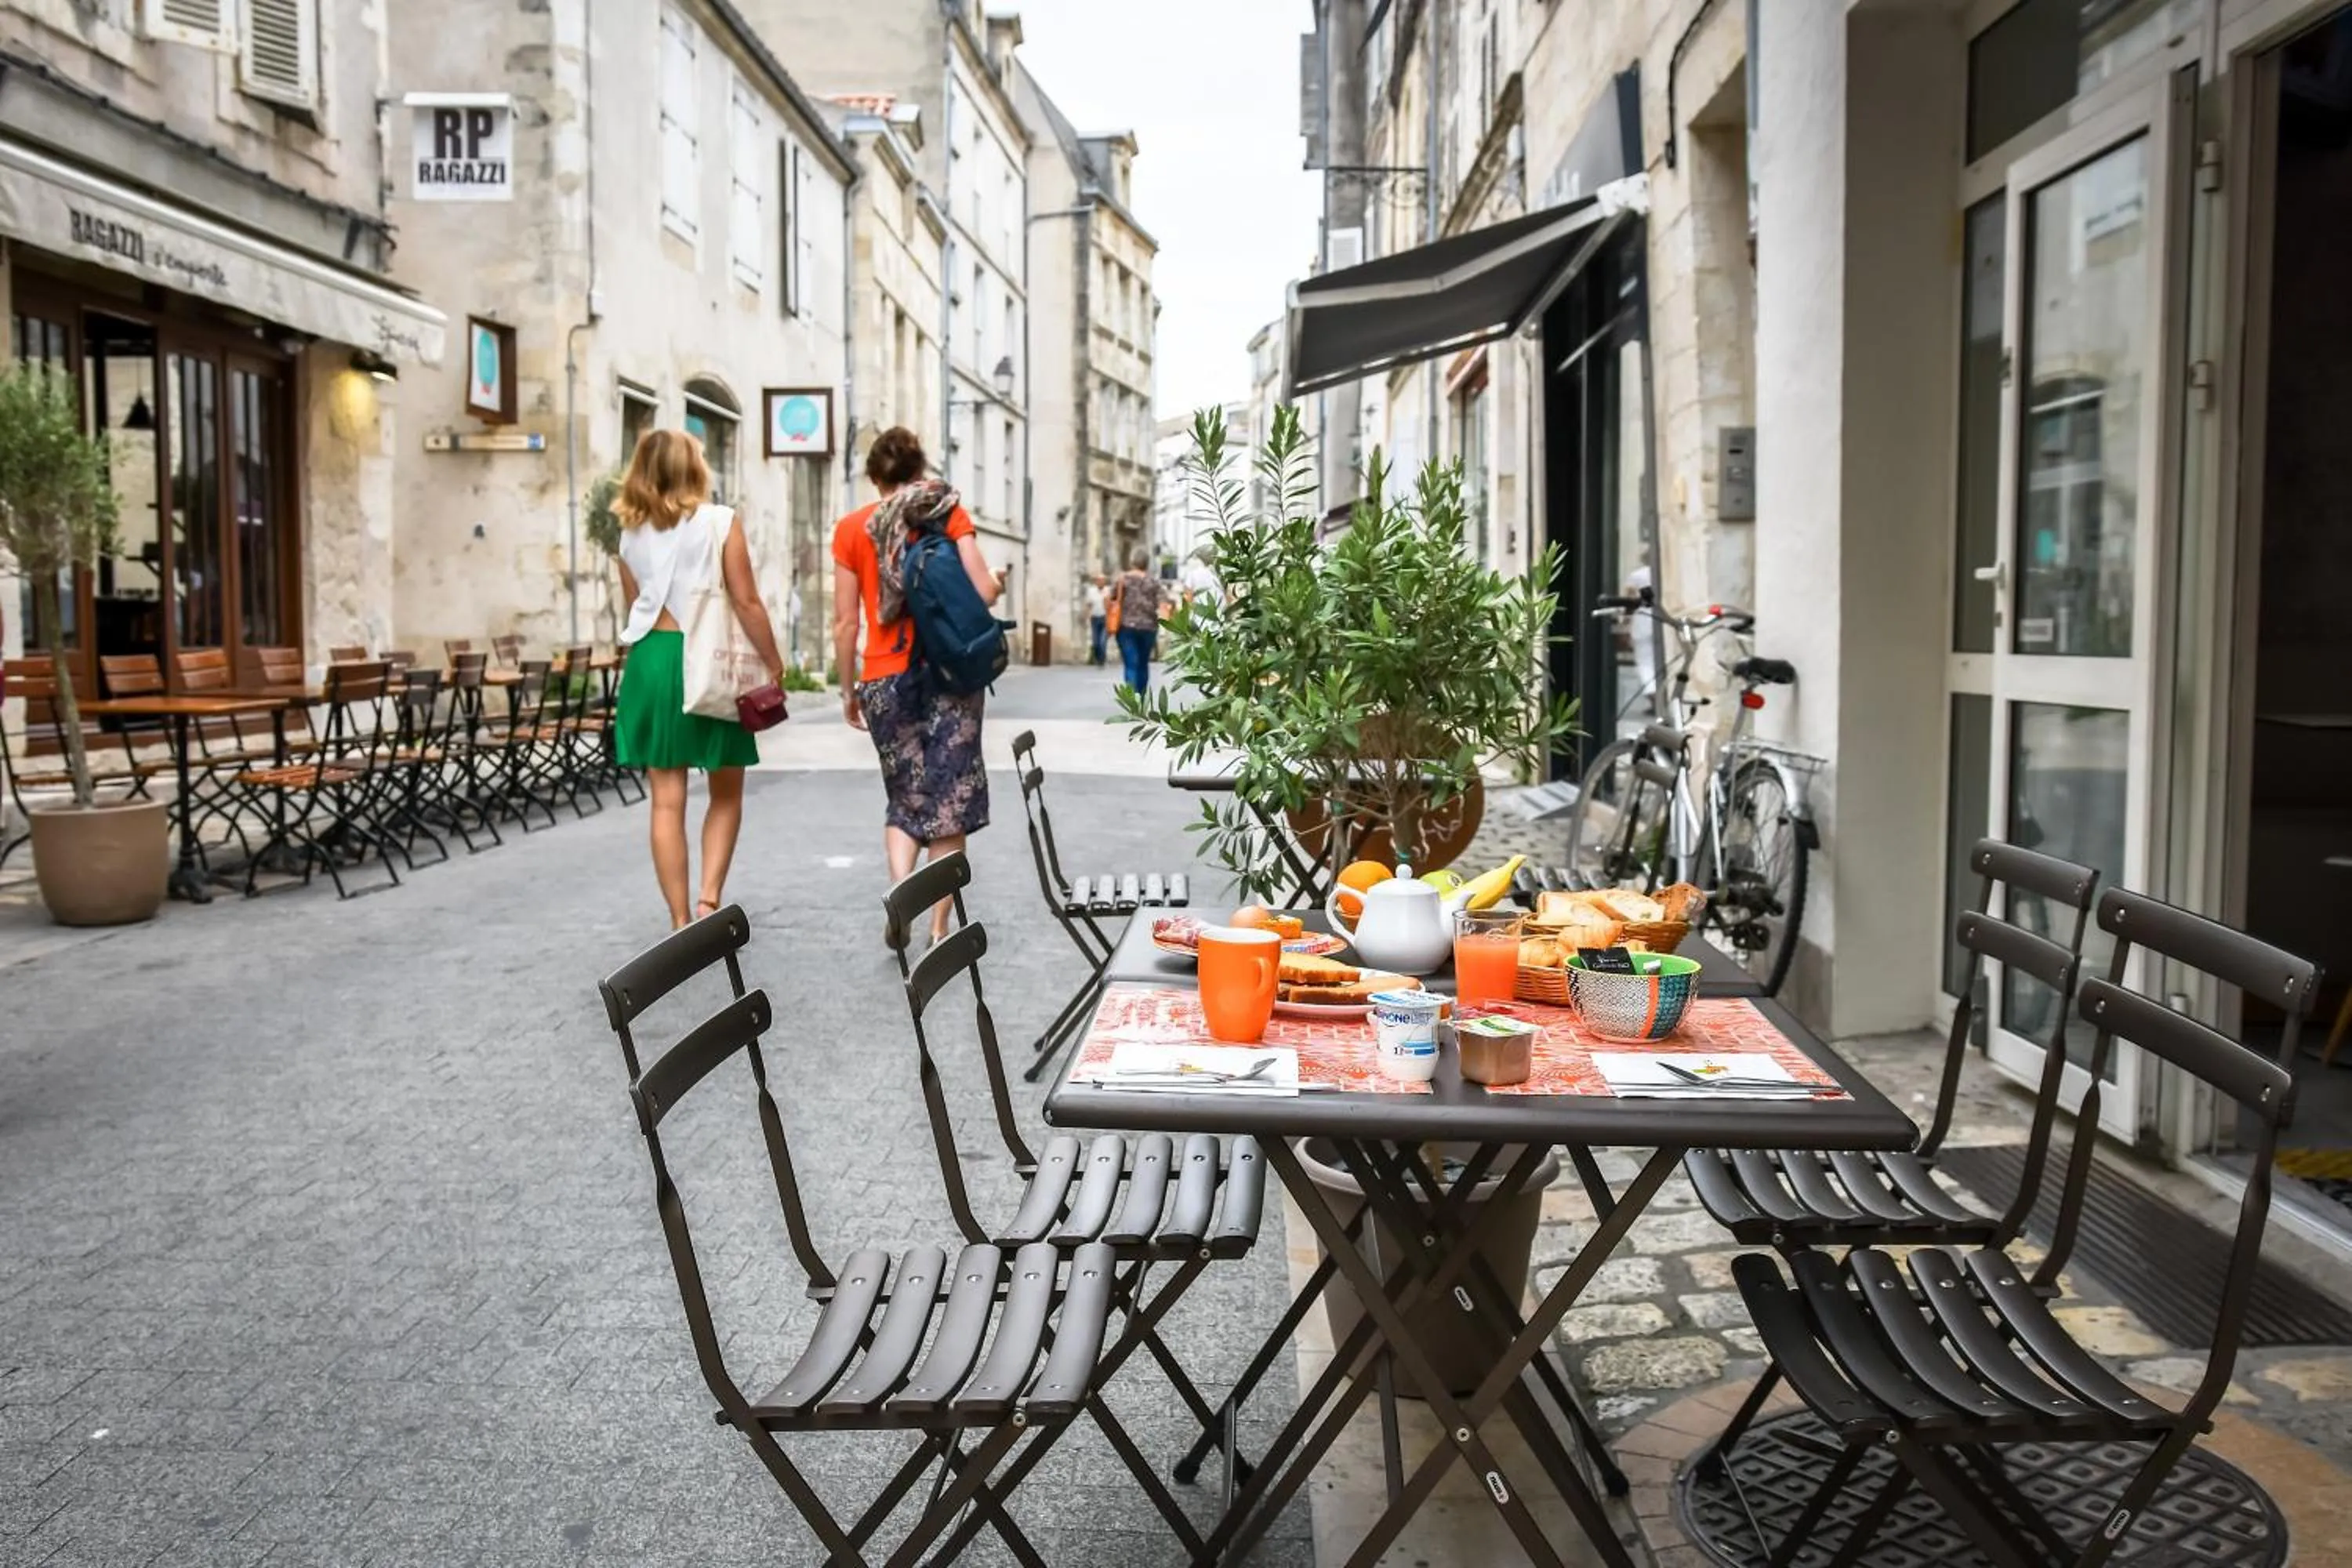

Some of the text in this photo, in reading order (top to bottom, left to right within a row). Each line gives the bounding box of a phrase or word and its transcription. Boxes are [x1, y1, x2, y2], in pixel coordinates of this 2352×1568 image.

[434, 107, 493, 159] RP
[419, 162, 506, 183] RAGAZZI
[70, 209, 144, 265] RAGAZZI
